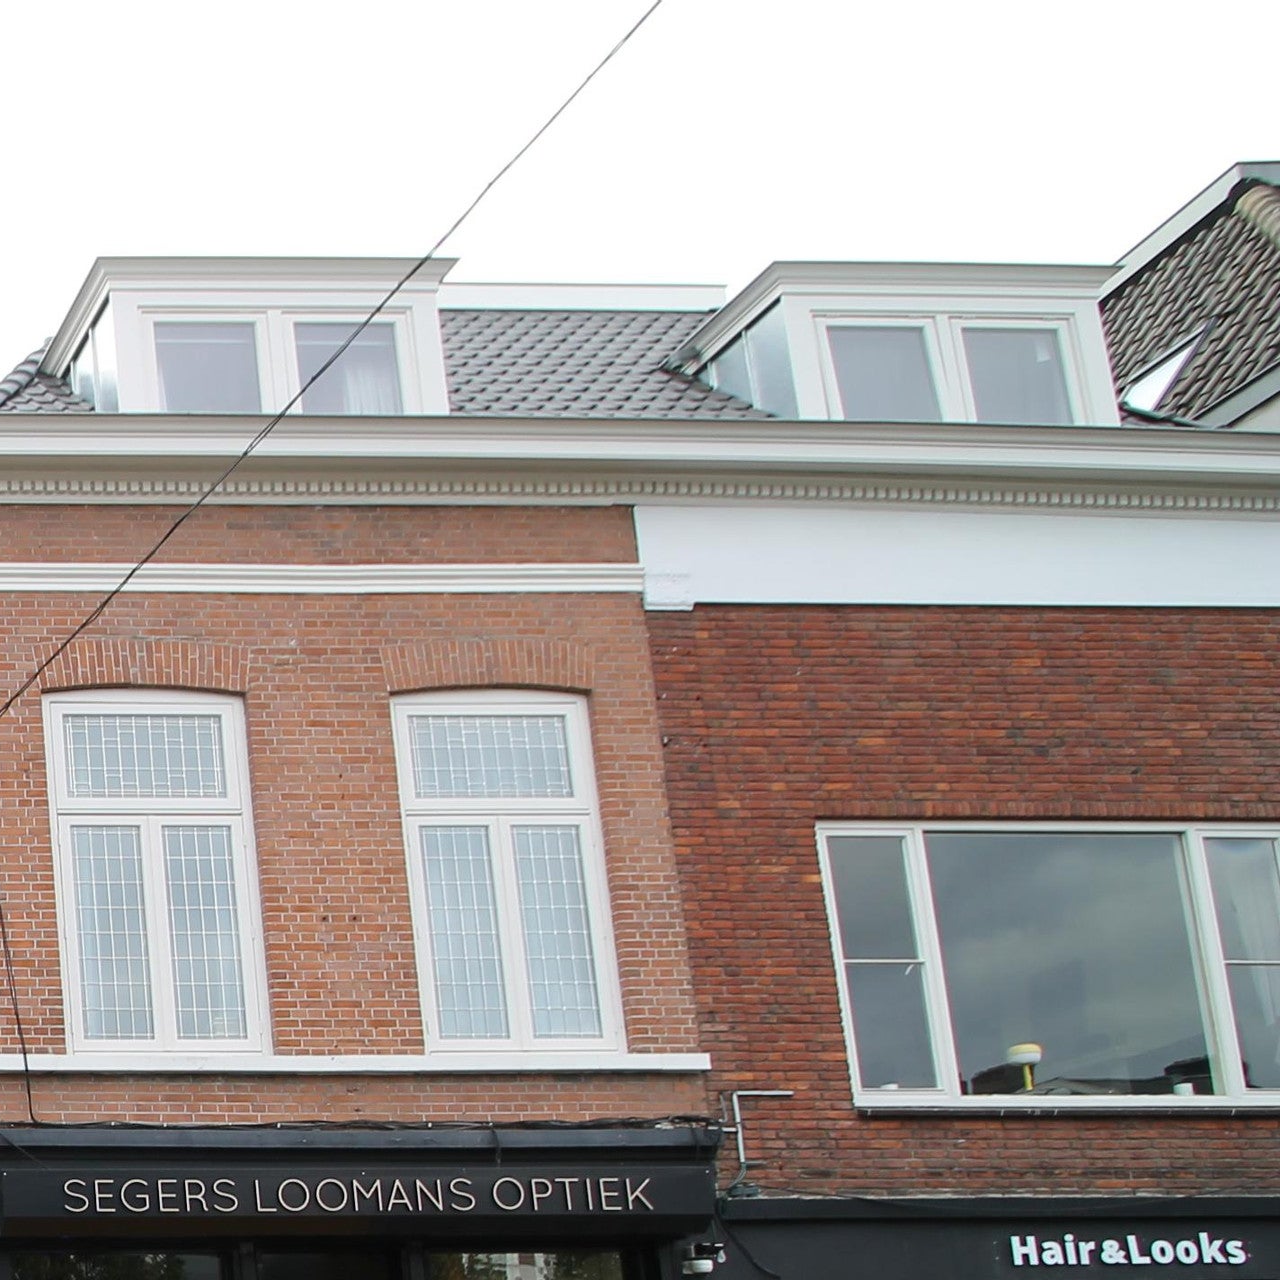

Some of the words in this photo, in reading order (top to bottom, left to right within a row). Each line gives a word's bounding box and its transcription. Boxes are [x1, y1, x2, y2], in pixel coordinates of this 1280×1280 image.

[63, 1179, 239, 1213] SEGERS
[254, 1178, 476, 1213] LOOMANS
[493, 1177, 654, 1212] OPTIEK
[1009, 1231, 1248, 1266] Hair&Looks
